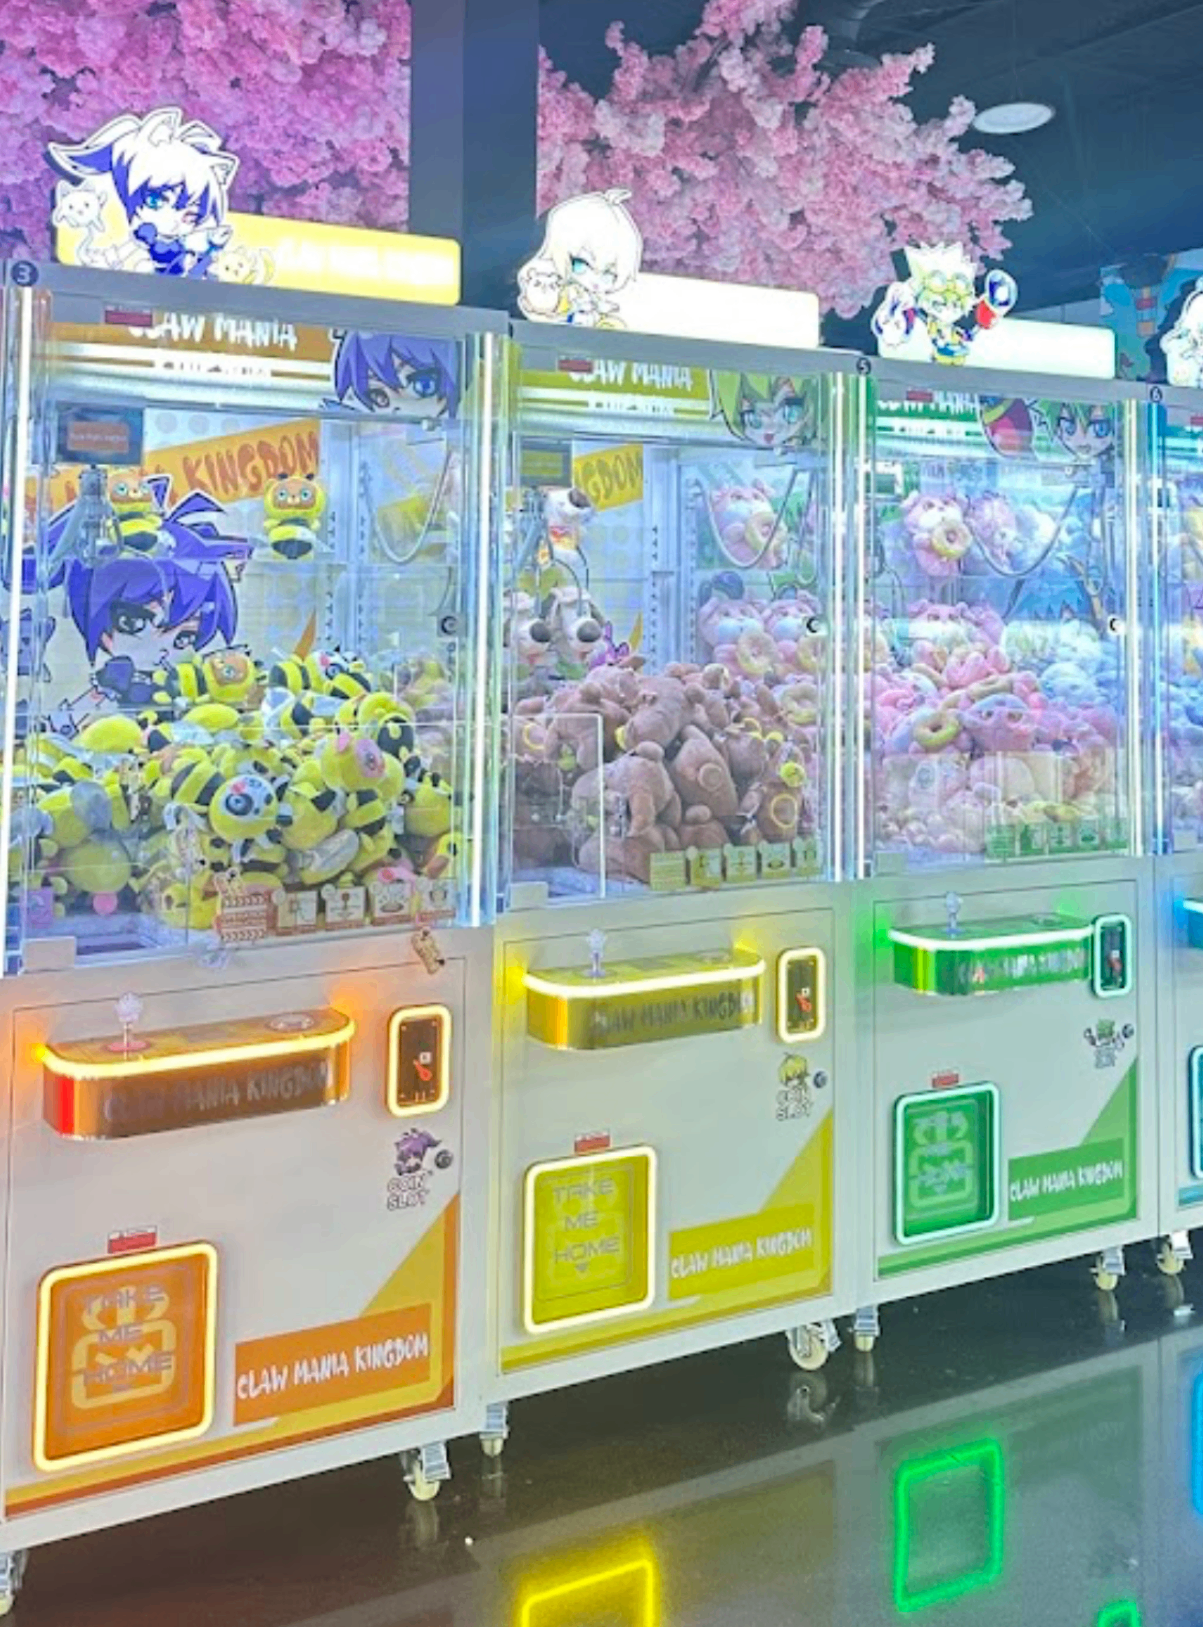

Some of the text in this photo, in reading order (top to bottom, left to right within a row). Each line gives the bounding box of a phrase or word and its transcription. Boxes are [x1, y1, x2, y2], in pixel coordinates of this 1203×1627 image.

[213, 312, 298, 351] MANIA
[181, 430, 320, 496] KINGDOM
[553, 1177, 614, 1202] TAKE
[564, 1210, 600, 1231] ME
[554, 1236, 620, 1264] HOME
[98, 1324, 143, 1344] ME
[236, 1331, 430, 1400] CLAW MANIA KINGDOM
